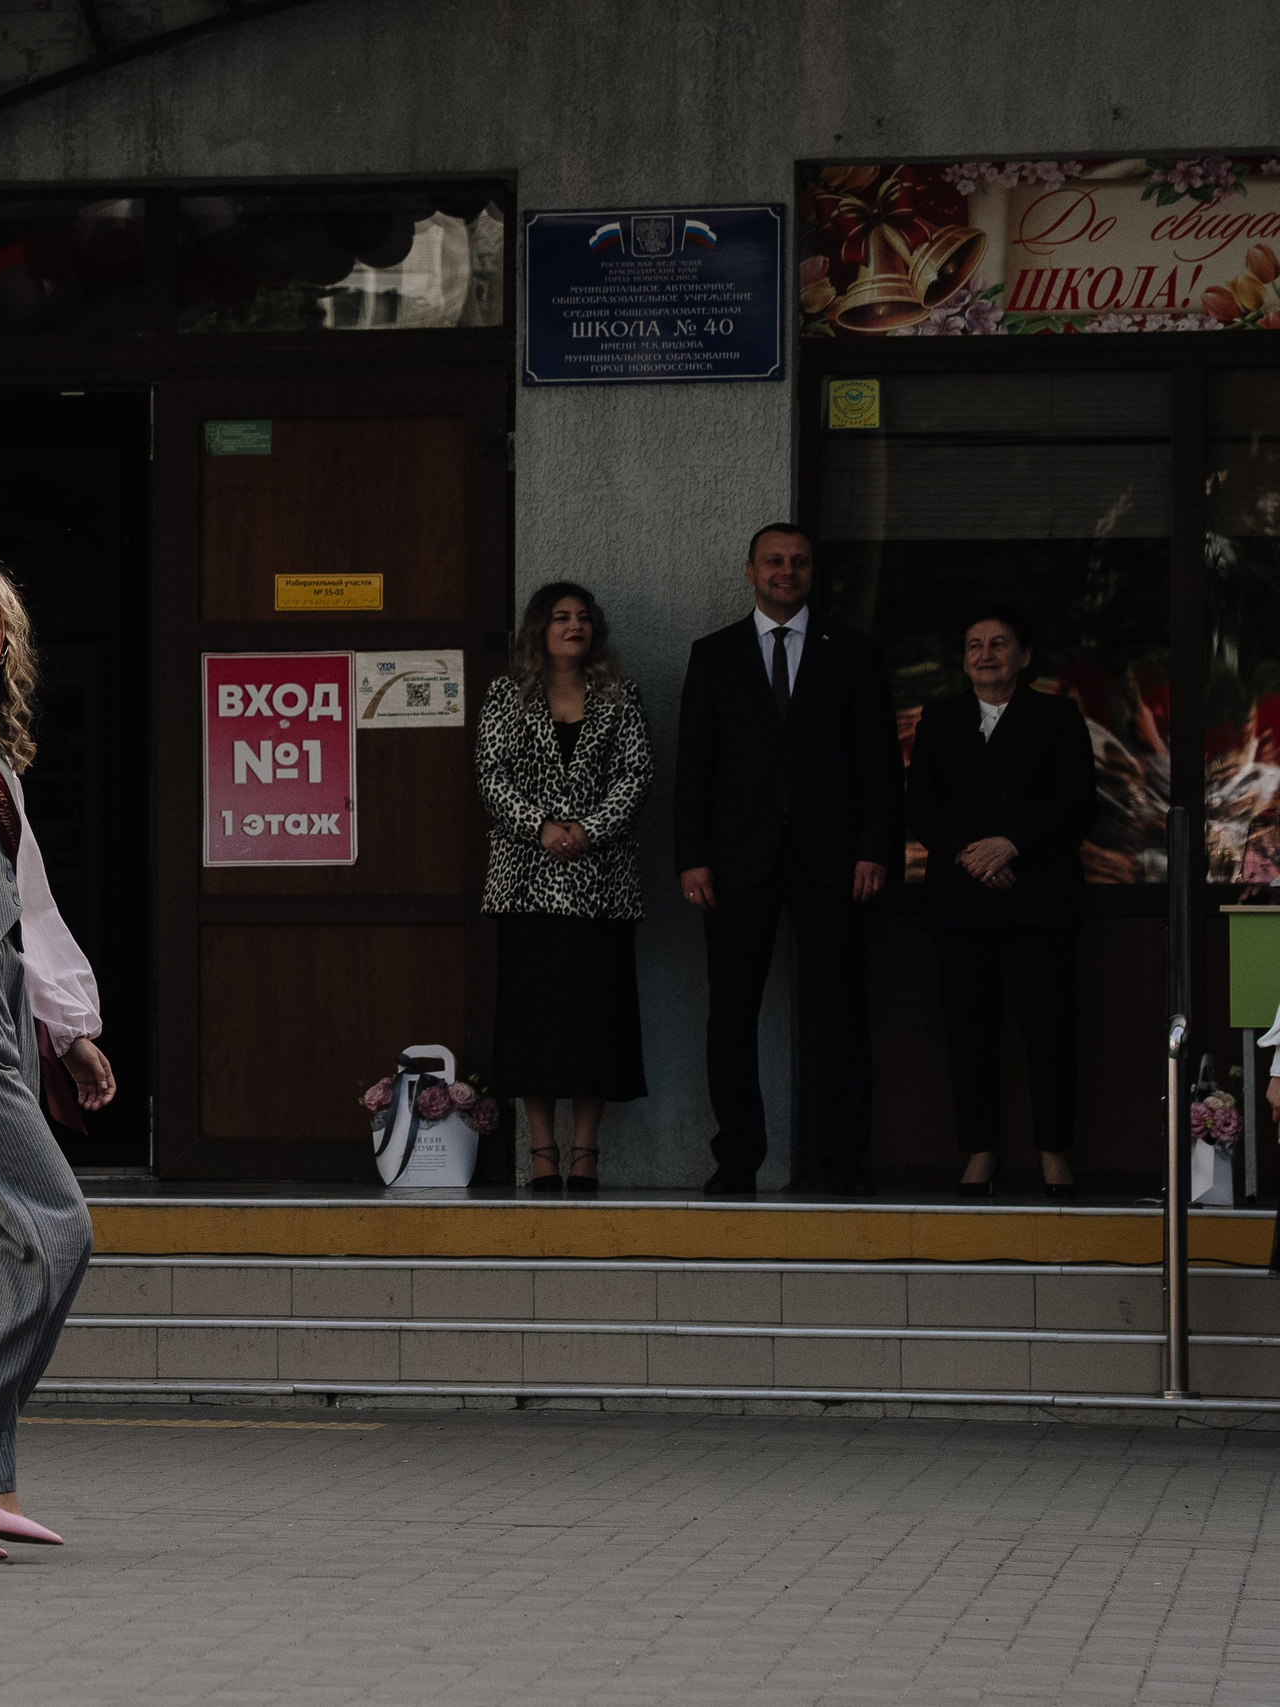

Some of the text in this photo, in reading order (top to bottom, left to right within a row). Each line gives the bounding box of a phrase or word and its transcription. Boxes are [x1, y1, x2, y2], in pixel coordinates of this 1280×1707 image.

[1011, 188, 1118, 255] До
[569, 282, 736, 294] МУНИЦИПАЛЬНОЕ АВТОНОМНОЕ
[1006, 264, 1204, 312] ШКОЛА!
[551, 292, 754, 305] ОБЩЕОБРАЗОВАТЕЛЬНОЕ УЧРЕЖДЕНИЕ
[563, 306, 741, 318] СРЕДНЯЯ ОБЩЕОБРАЗОВАТЕЛЬНАЯ
[571, 318, 734, 338] ШКОЛА № 40
[600, 341, 637, 350] ИМЕНИ
[564, 351, 740, 363] МУНИЦИПАЛЬНОГО ОБРАЗОВАНИЯ
[590, 362, 714, 373] ГОРОД НОВОРОССИЙСК
[285, 578, 372, 588] Избирательный участок
[217, 683, 342, 722] ВХОД
[233, 739, 322, 784] №1
[221, 810, 341, 836] 1 этаж
[417, 1136, 442, 1144] RESH
[414, 1144, 447, 1152] OWER
